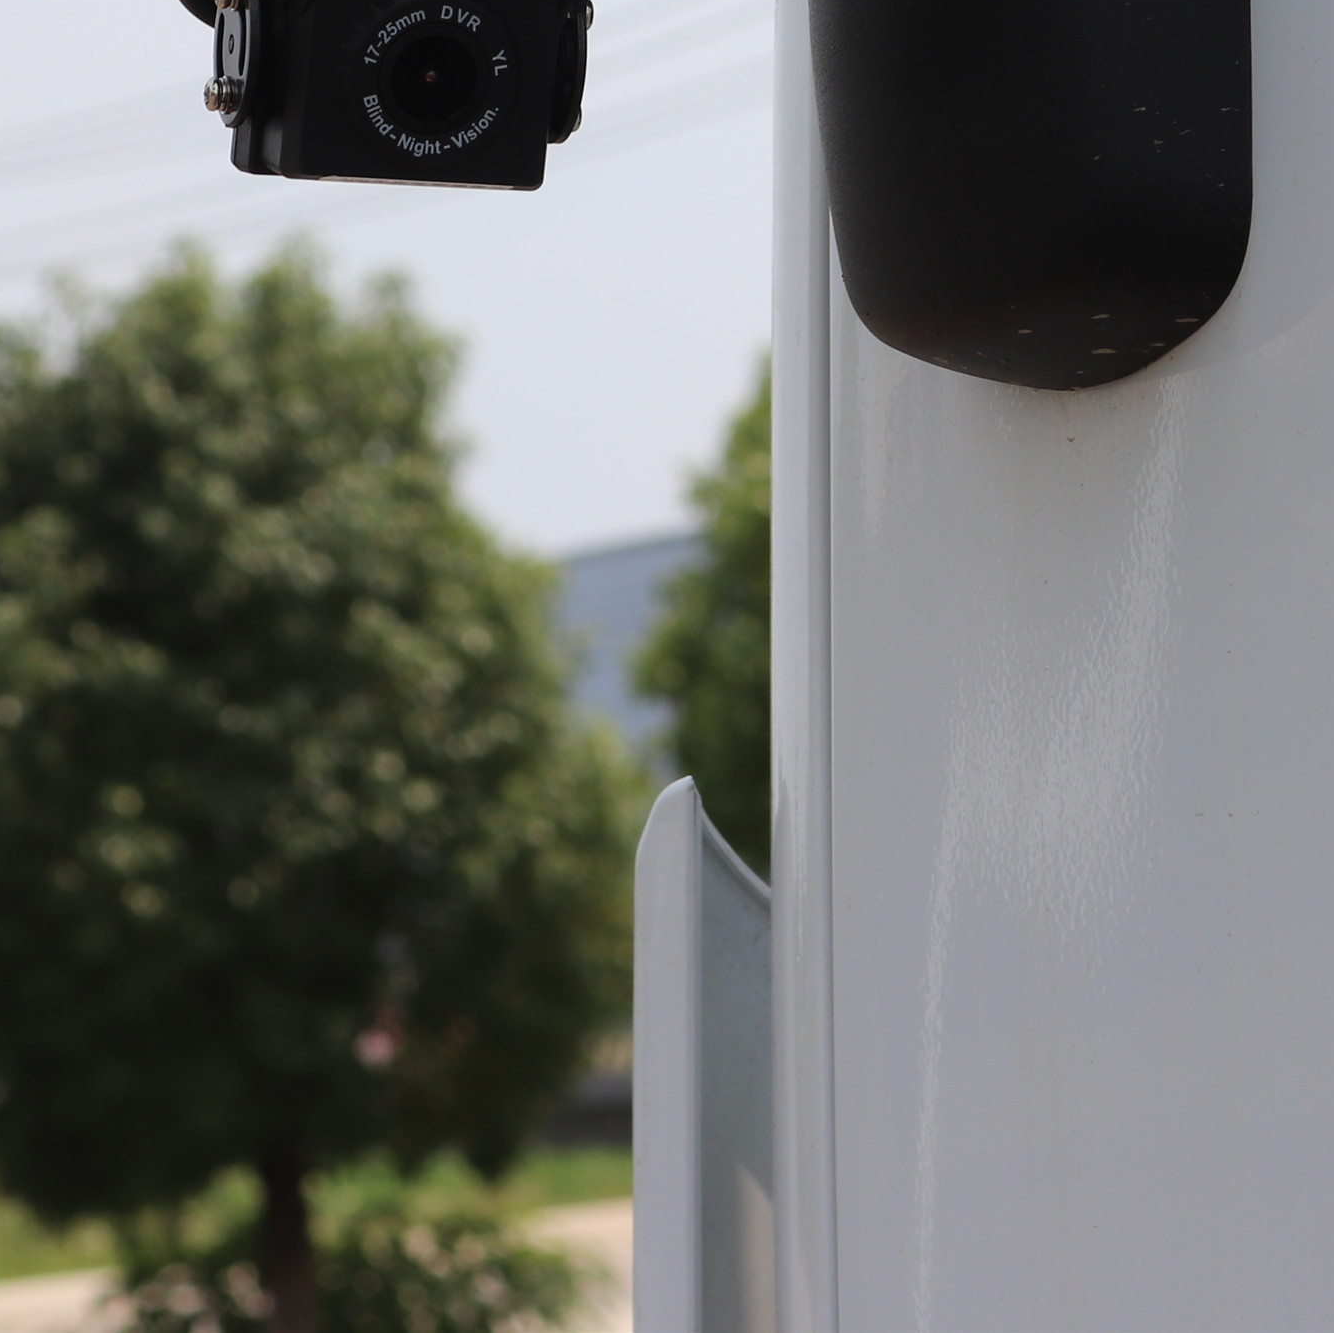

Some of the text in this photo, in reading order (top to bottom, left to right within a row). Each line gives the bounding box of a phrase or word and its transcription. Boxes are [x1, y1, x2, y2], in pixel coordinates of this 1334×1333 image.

[364, 5, 508, 76] 17-25mm DVR YL
